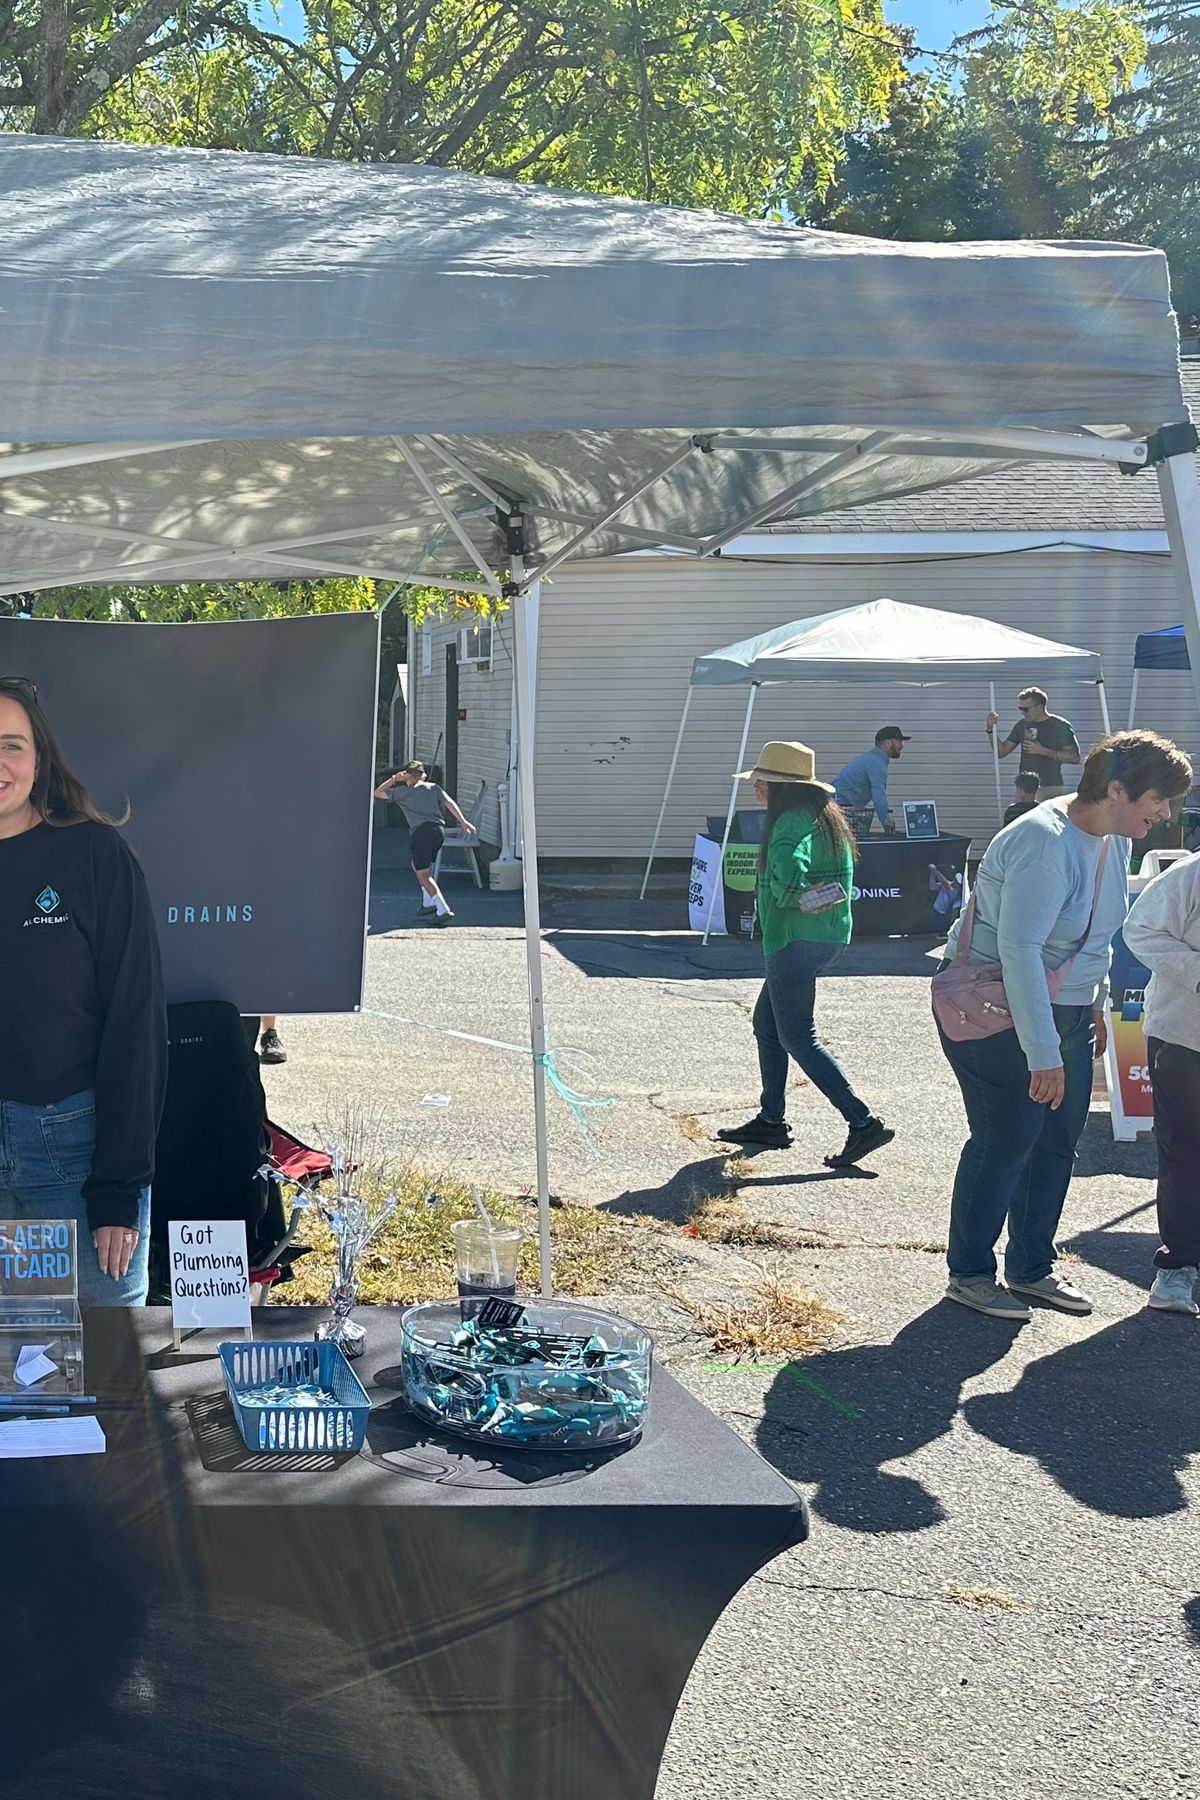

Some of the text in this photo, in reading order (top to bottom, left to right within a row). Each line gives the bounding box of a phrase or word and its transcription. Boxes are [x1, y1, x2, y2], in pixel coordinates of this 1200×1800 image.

[22, 912, 70, 928] ALCHEMIC
[167, 904, 253, 923] DRAINS
[13, 1223, 69, 1250] AERO
[180, 1225, 214, 1245] Got
[173, 1251, 244, 1277] Plumbing
[175, 1277, 248, 1299] Questions?
